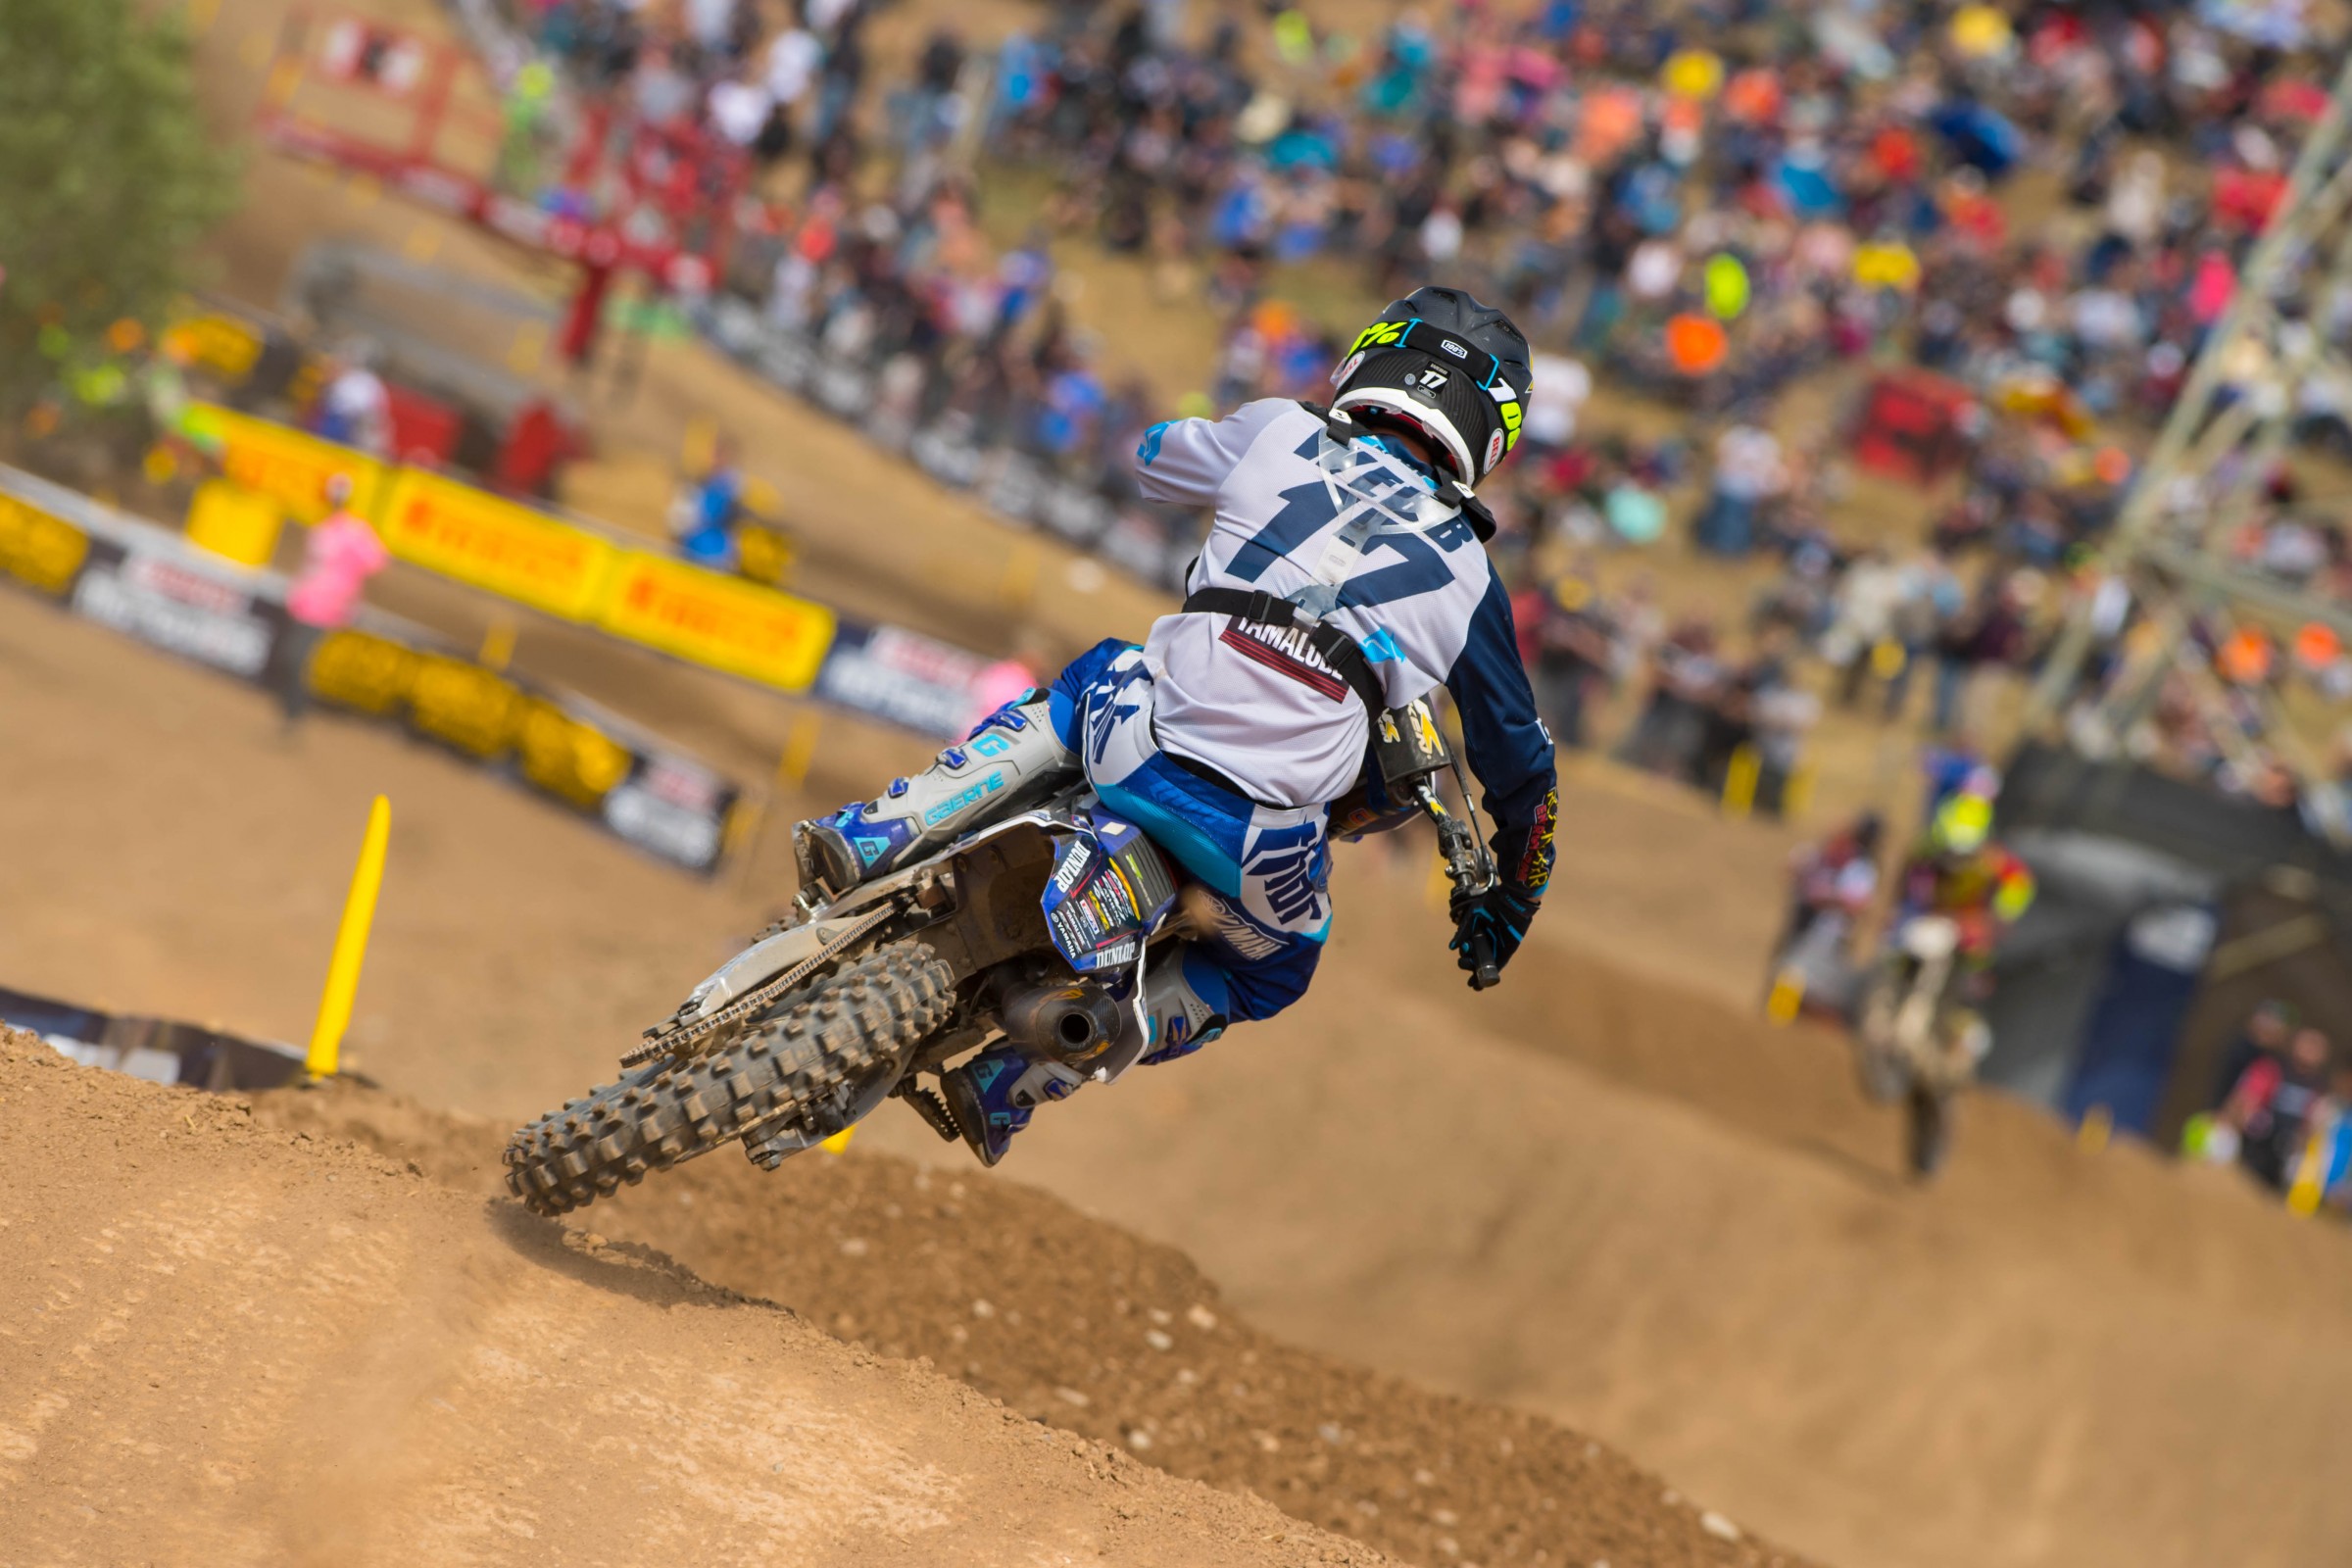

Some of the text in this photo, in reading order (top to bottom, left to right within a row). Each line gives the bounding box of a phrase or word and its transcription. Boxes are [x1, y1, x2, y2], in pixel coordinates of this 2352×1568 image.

[1443, 341, 1466, 357] 100%
[1419, 369, 1448, 389] 17
[1488, 436, 1501, 467] BELL
[1293, 425, 1475, 554] WEBB
[1224, 478, 1456, 619] 17
[924, 769, 1004, 826] GAERNE
[1054, 840, 1092, 894] DUNLOP
[1057, 921, 1076, 959] YAMAHA
[1096, 941, 1136, 969] DUNLOP
